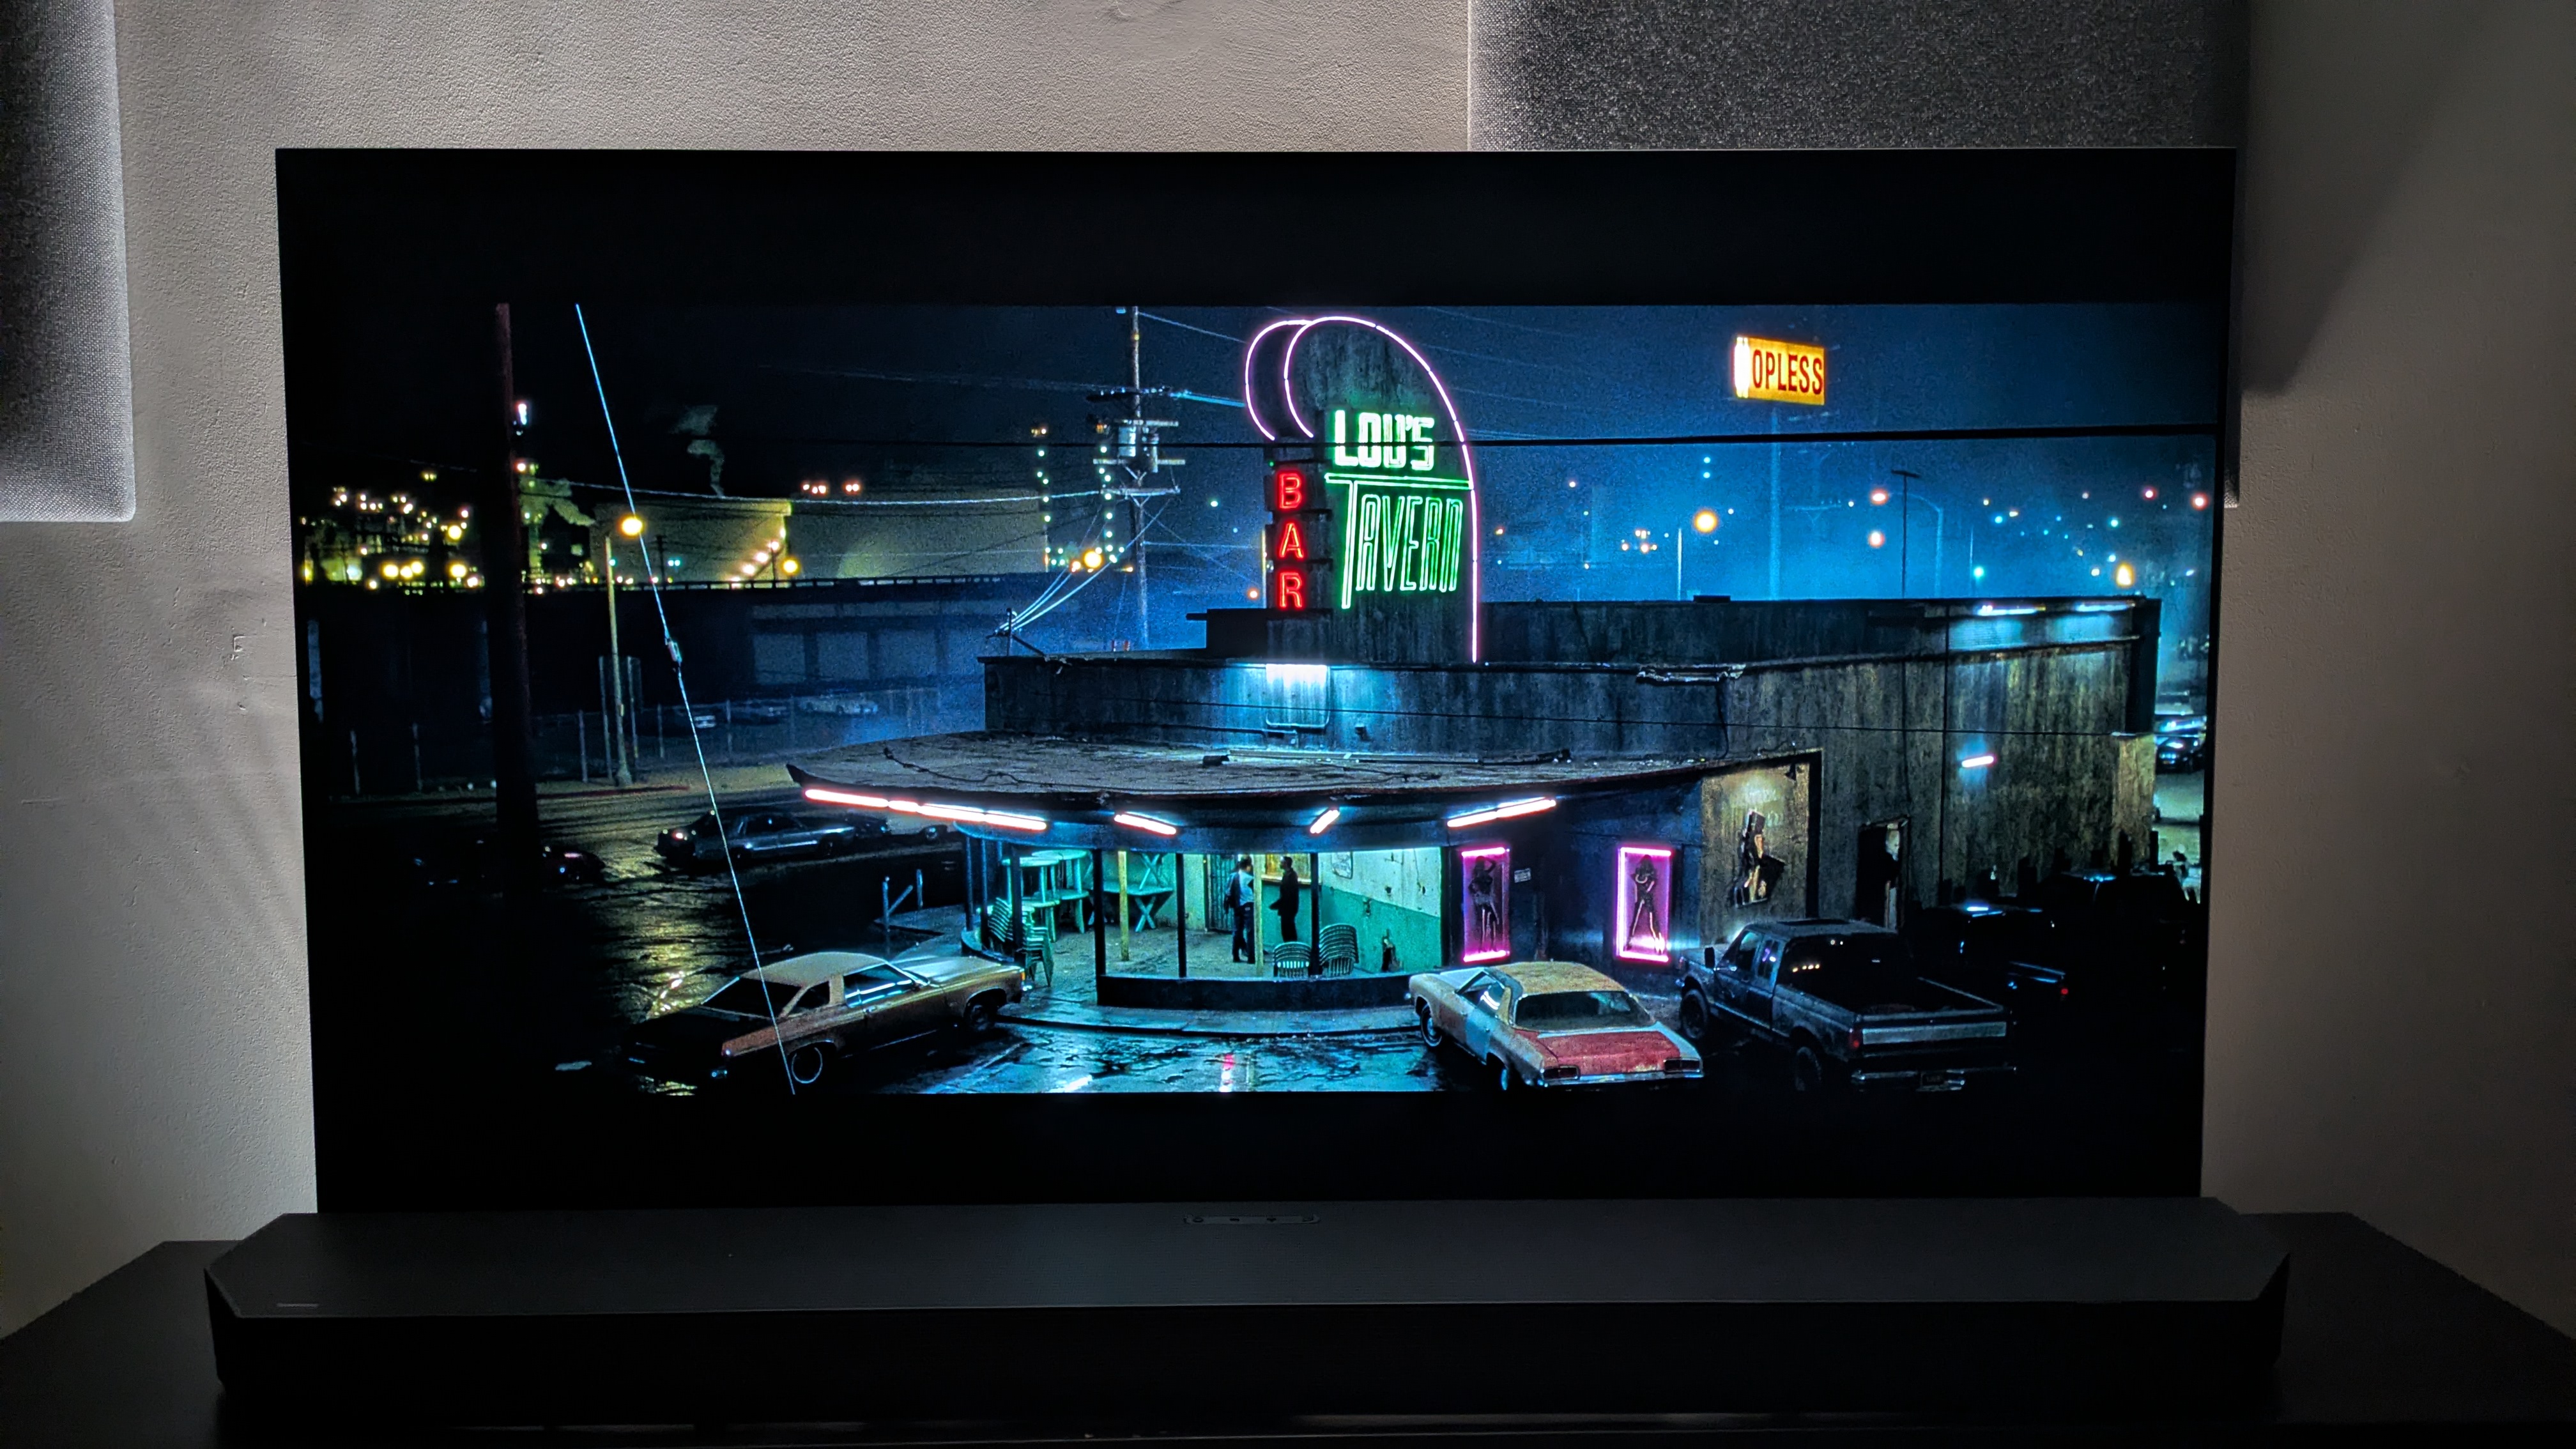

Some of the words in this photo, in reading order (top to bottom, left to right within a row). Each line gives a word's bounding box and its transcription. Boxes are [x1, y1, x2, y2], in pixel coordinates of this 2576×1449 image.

[1334, 410, 1435, 471] LOU'S
[1278, 472, 1305, 610] BAR
[1324, 473, 1473, 610] TAVERN
